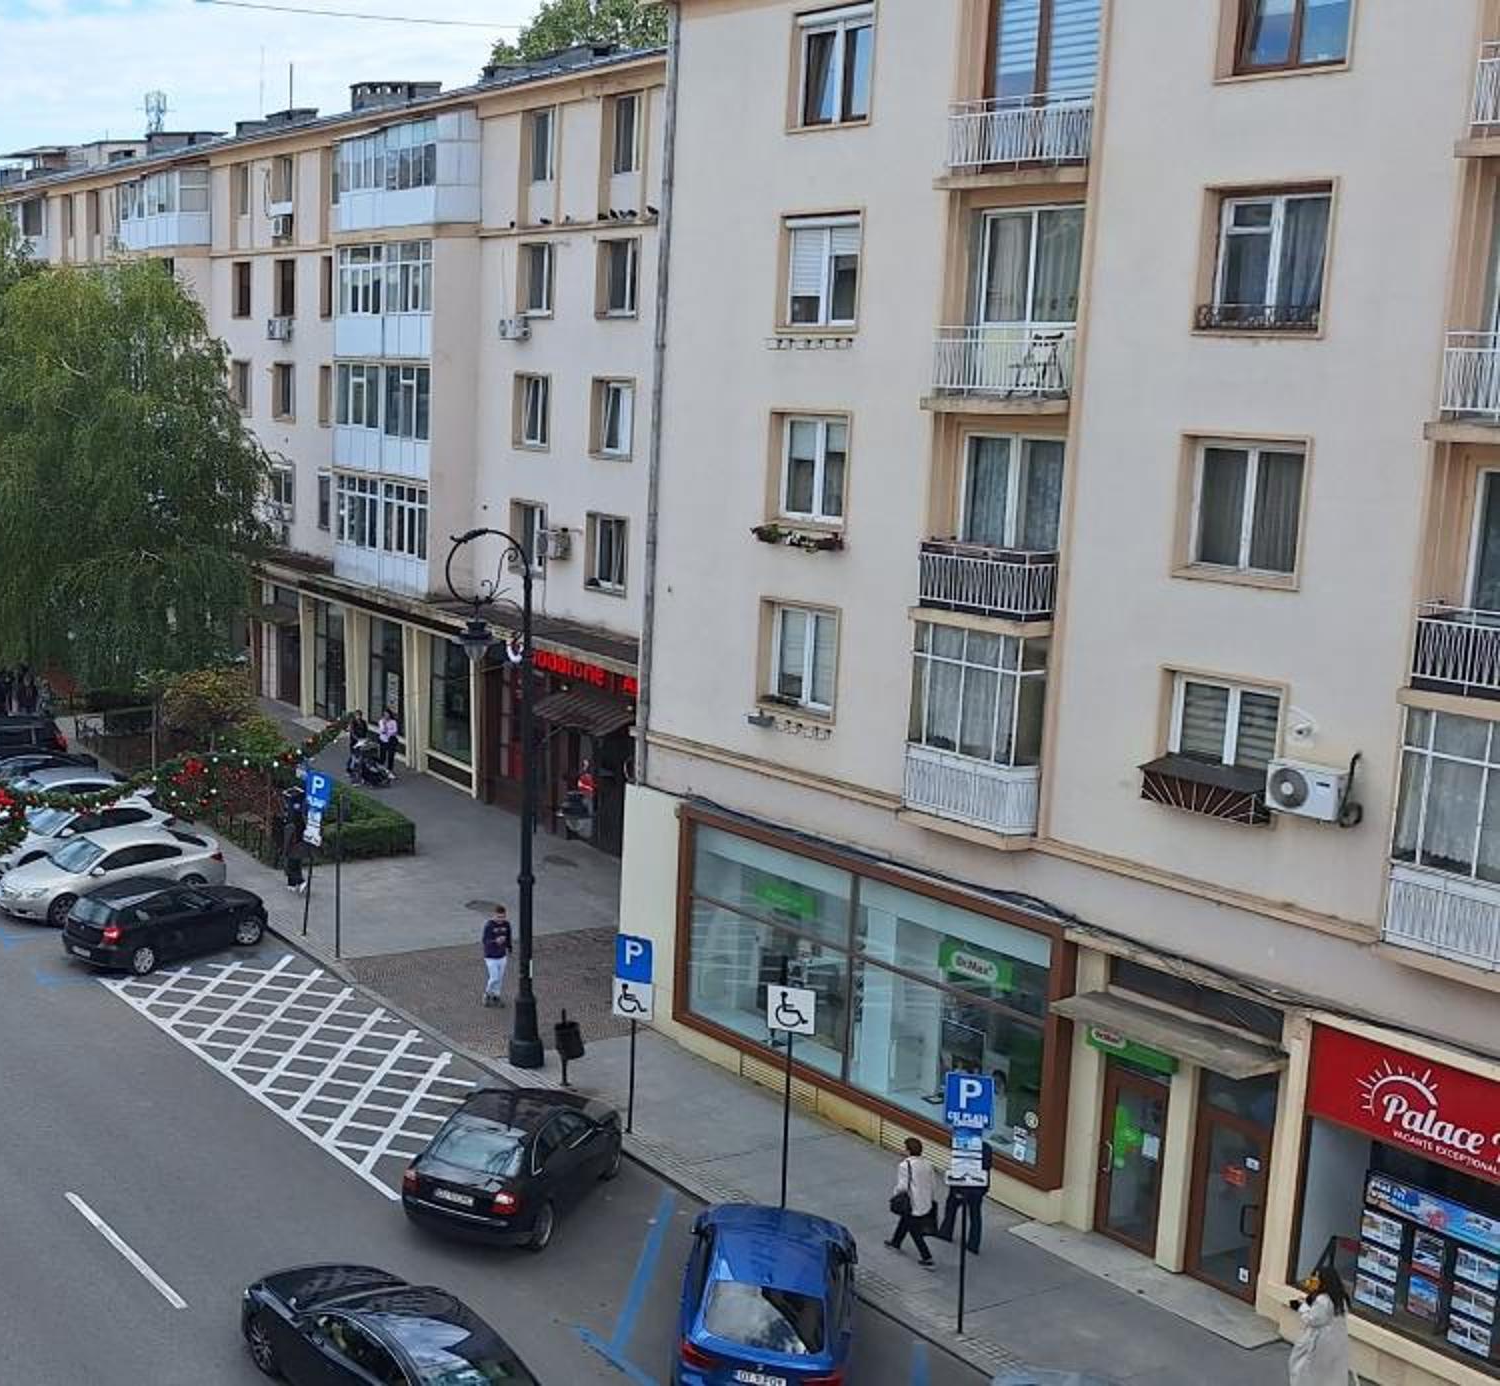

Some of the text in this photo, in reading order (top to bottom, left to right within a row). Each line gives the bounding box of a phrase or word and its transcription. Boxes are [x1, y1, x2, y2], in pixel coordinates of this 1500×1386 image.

[311, 775, 325, 795] P
[625, 939, 643, 965] P
[959, 1078, 983, 1109] P
[1382, 1093, 1485, 1155] Palace
